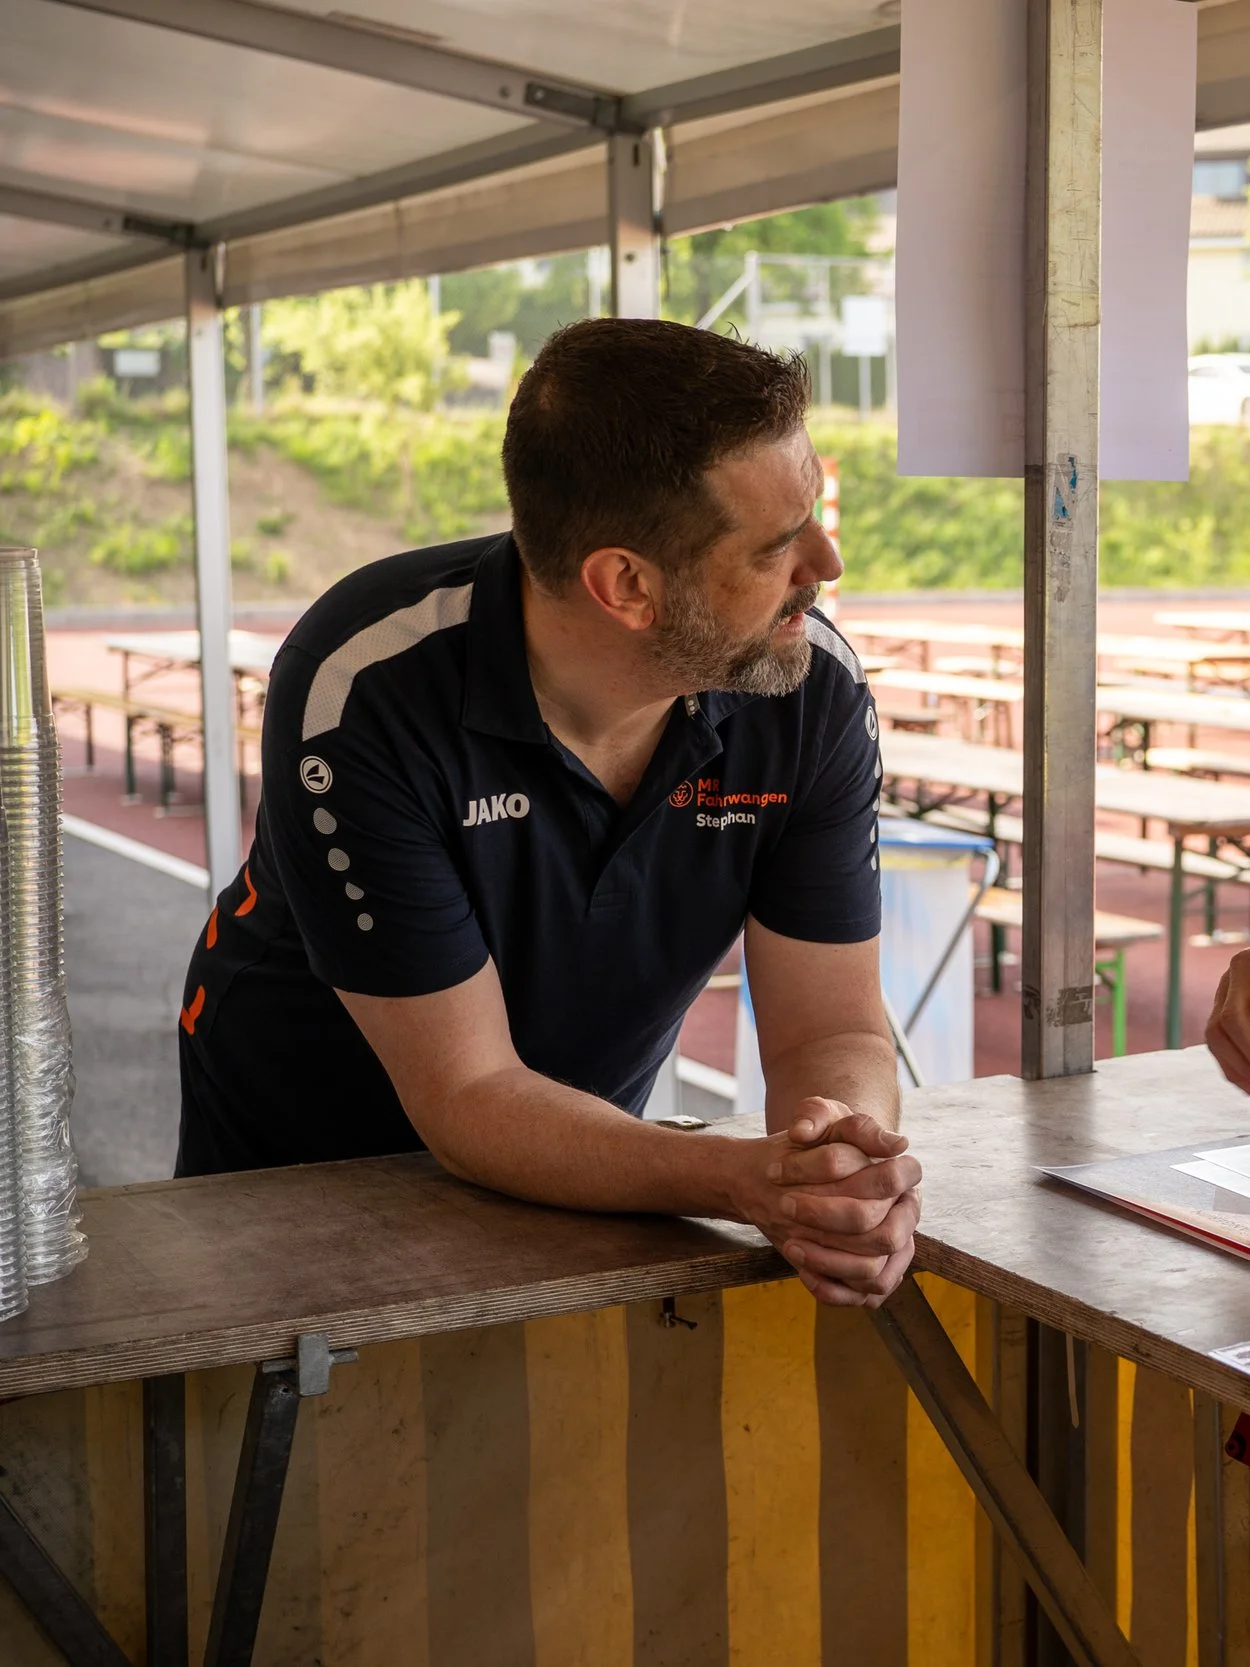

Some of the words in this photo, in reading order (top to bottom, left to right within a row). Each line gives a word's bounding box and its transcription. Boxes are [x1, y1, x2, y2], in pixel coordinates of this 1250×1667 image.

[697, 778, 719, 792] MR
[697, 792, 787, 808] Fahrwangen
[463, 792, 530, 827] JAKO
[696, 813, 755, 831] Stephan
